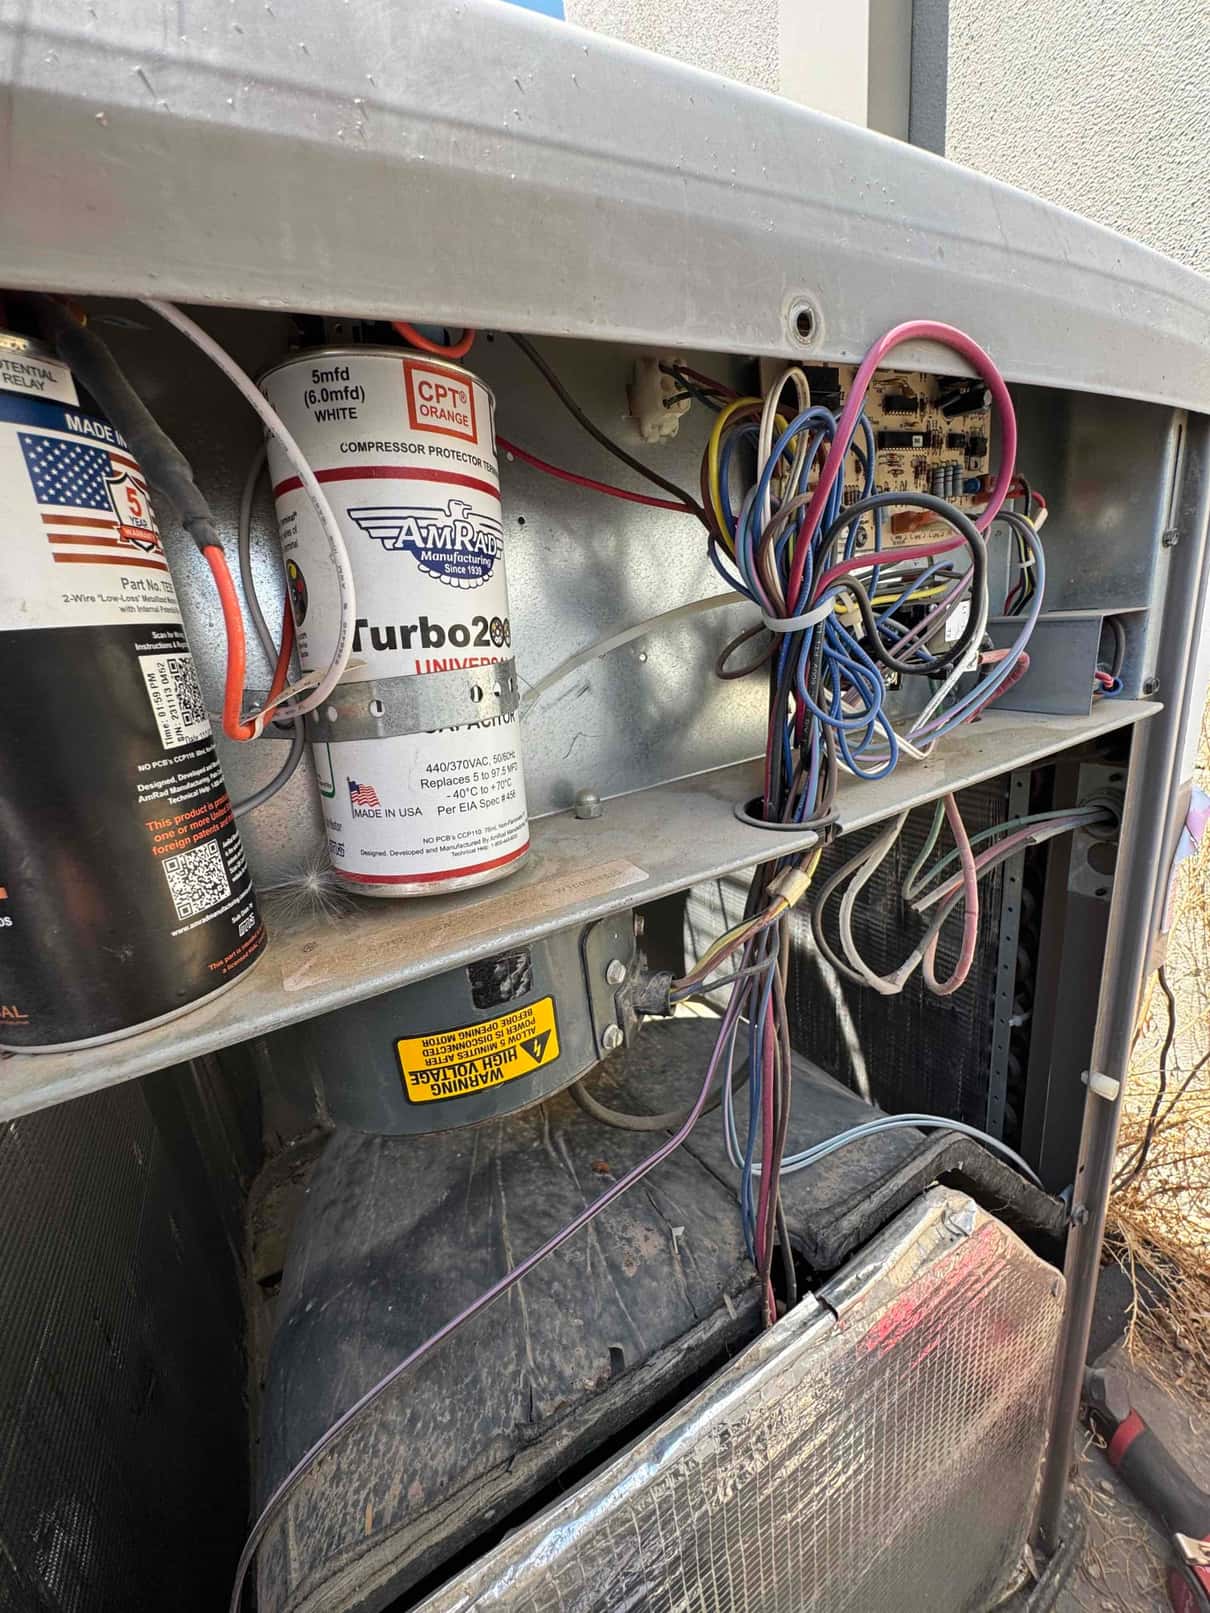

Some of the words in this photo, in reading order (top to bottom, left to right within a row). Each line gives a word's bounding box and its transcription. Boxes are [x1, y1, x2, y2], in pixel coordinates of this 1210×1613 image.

[0, 360, 57, 382] TENTIAL
[312, 367, 350, 384] 5mfd
[3, 373, 45, 391] RELAY
[304, 386, 365, 408] (6.0mfd)
[314, 408, 357, 423] WHITE
[420, 404, 468, 426] ORANGE
[65, 414, 114, 443] MADE
[340, 440, 425, 455] COMPRESSOR
[428, 446, 483, 468] PROTECTOR
[483, 460, 498, 475] TER
[126, 487, 142, 517] 5
[420, 551, 491, 567] Manufacturing
[445, 564, 466, 575] Since
[121, 577, 146, 592] Part
[146, 578, 160, 592] No.
[147, 673, 158, 689] PM
[153, 691, 167, 717] 01:59
[166, 688, 179, 721] 231113
[161, 719, 174, 746] Time:
[425, 756, 491, 773] 440/370VAC,
[137, 776, 178, 793] Designed,
[420, 775, 470, 789] Replaces
[473, 772, 479, 783] 5
[481, 771, 490, 780] to
[138, 790, 169, 804] AmRad
[167, 788, 199, 805] Technical
[480, 785, 489, 794] to
[354, 808, 381, 818] MADE
[385, 807, 396, 818] IN
[399, 806, 423, 817] USA
[437, 805, 456, 816] Per
[459, 801, 478, 813] EIA
[479, 796, 500, 810] Spec
[145, 817, 173, 832] This
[174, 804, 208, 826] product
[154, 829, 176, 842] one
[177, 824, 188, 835] or
[190, 816, 210, 831] more
[152, 836, 191, 856] foreign
[193, 822, 220, 843] patents
[389, 847, 424, 858] Developed
[426, 846, 438, 854] and
[439, 838, 481, 852] Manufactured
[423, 836, 434, 844] NO
[0, 1004, 29, 1018] AL
[501, 1007, 533, 1027] BEFORE
[458, 1022, 498, 1040] OPENING
[495, 1030, 504, 1040] IS
[507, 1017, 536, 1035] POWER
[508, 1026, 536, 1044] ALLOW
[422, 1035, 456, 1048] MOTOR
[423, 1035, 493, 1058] DISCONNECTED
[501, 1039, 506, 1048] 5
[457, 1043, 498, 1060] MINUTES
[482, 1047, 518, 1068] HIGH
[425, 1055, 454, 1067] AFTER
[411, 1063, 481, 1086] VOLTAGE
[431, 1068, 504, 1096] WARNING
